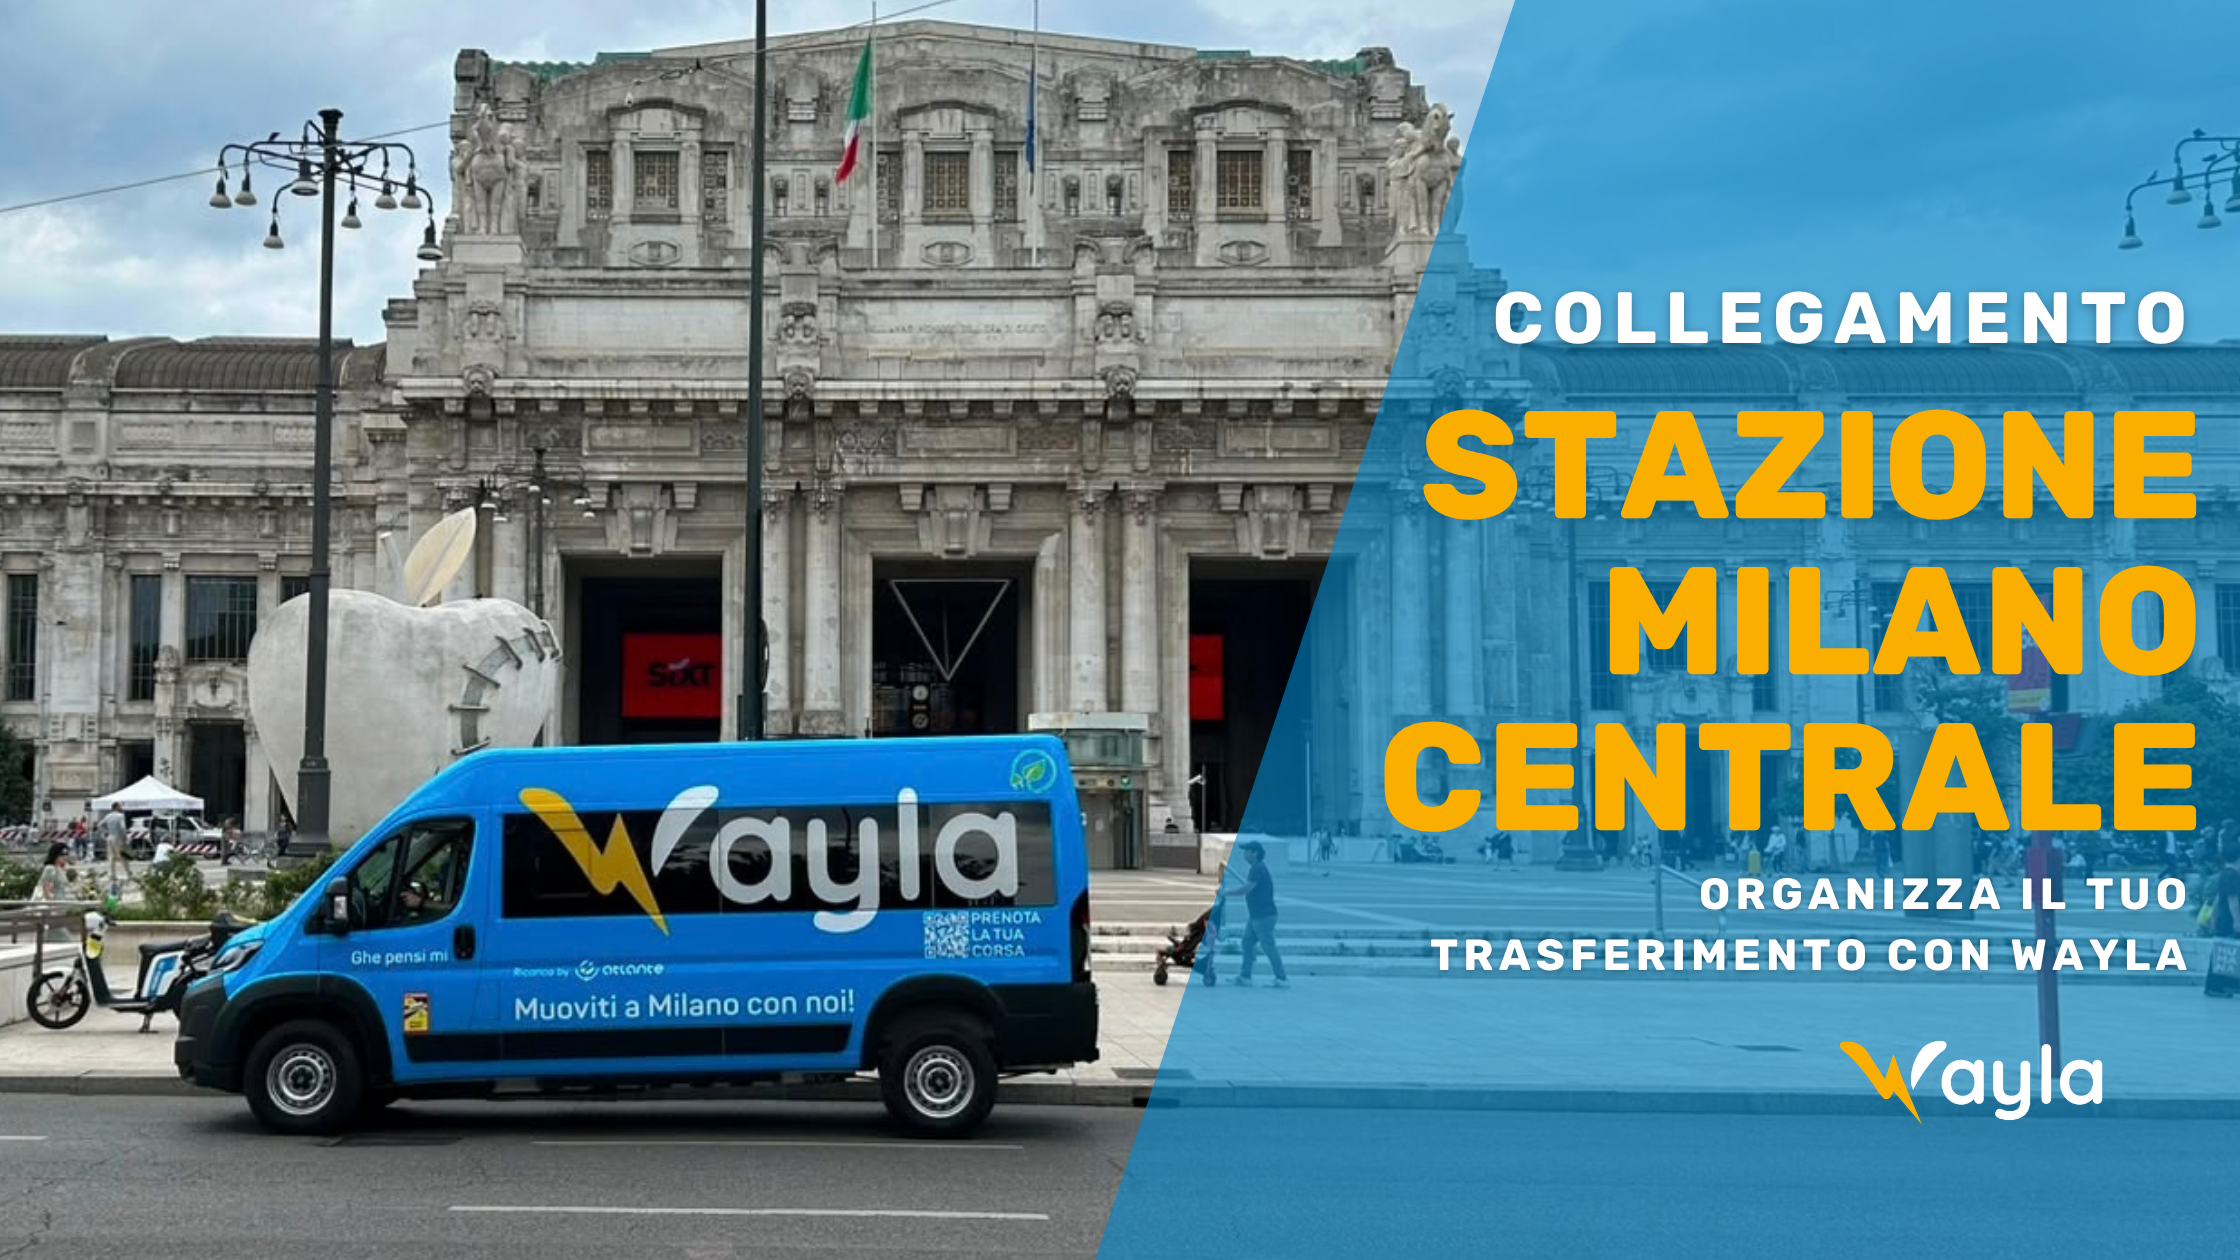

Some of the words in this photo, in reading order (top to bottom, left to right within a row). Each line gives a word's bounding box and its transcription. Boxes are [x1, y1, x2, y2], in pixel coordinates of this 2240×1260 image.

[519, 785, 1019, 936] Wayla
[971, 911, 1041, 925] PRENOTA
[971, 928, 991, 941] LA
[993, 928, 1025, 941] TUA
[351, 949, 382, 965] Ghe
[385, 948, 426, 968] pensi
[429, 948, 449, 963] mi
[971, 943, 1025, 957] CORSA
[515, 994, 617, 1021] Muoviti
[624, 1000, 641, 1019] a
[649, 992, 740, 1018] Milano
[747, 996, 798, 1016] con
[806, 988, 855, 1015] noi!
